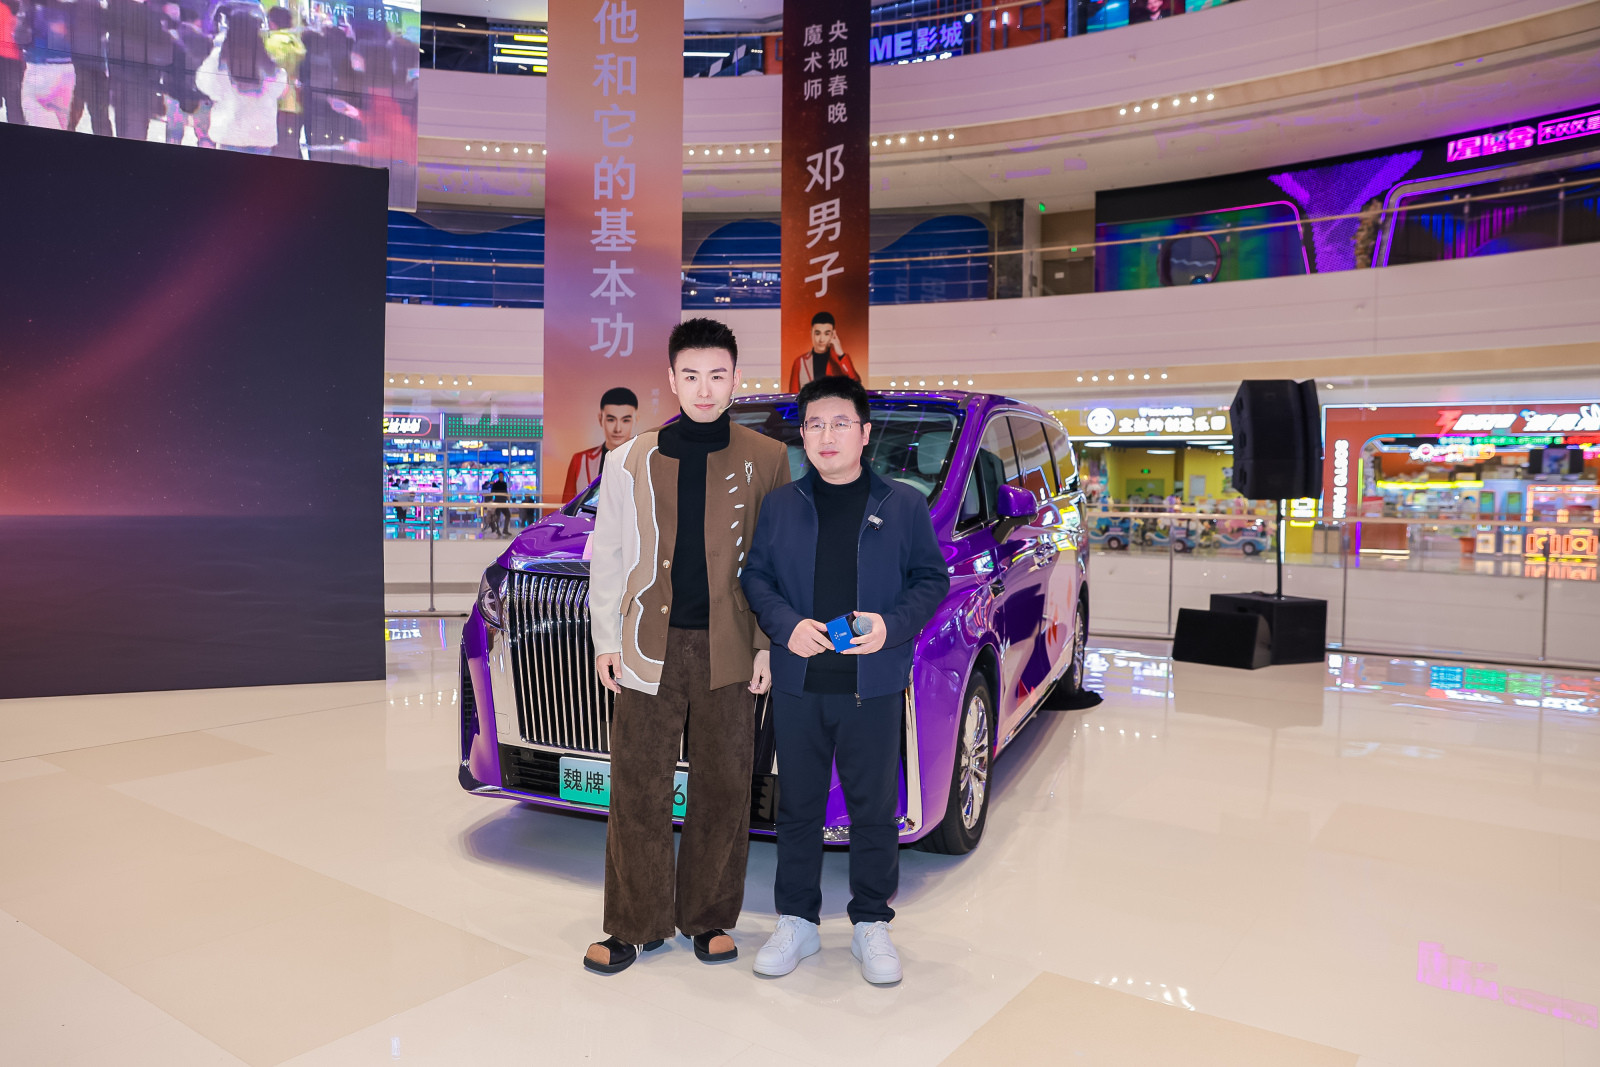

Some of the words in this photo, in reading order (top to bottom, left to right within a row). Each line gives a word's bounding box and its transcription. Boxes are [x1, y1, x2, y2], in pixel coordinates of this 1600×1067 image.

[803, 24, 822, 101] 魔术师
[827, 20, 848, 125] 央视春晚
[916, 21, 963, 53] 影城
[589, 0, 639, 358] 他和它的基本功
[803, 143, 845, 298] 邓男子
[563, 768, 611, 795] 魏牌
